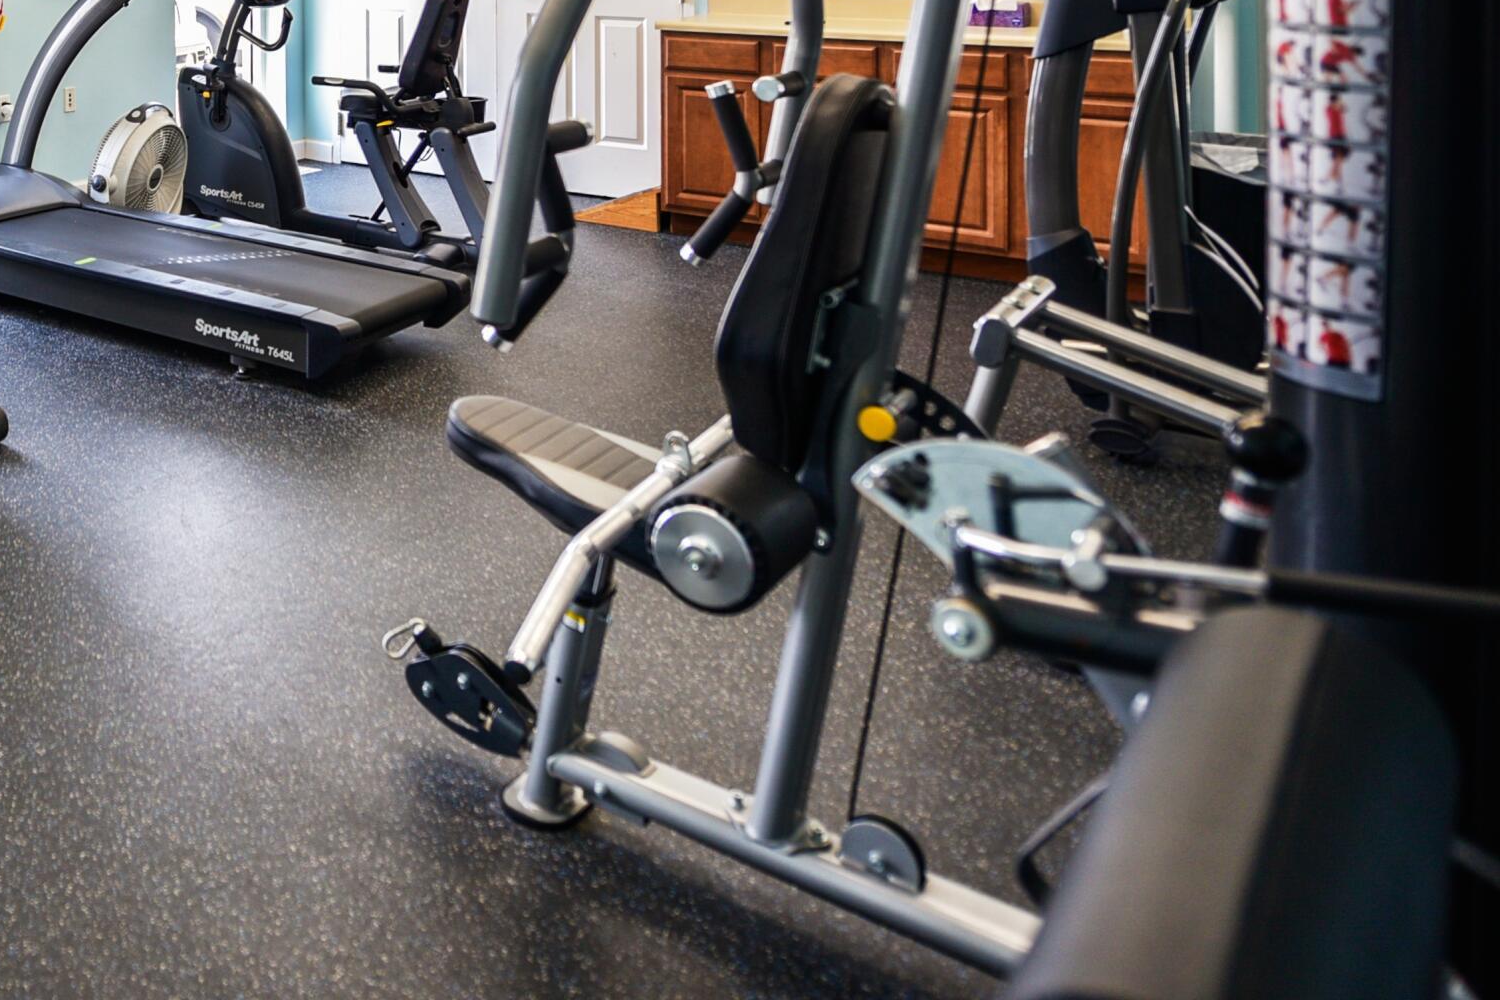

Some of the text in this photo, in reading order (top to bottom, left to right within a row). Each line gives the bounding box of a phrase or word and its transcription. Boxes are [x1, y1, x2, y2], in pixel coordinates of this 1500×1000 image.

[199, 184, 244, 201] SportsArt
[194, 318, 260, 347] SportsArt
[234, 342, 295, 363] FITNESS T645L
